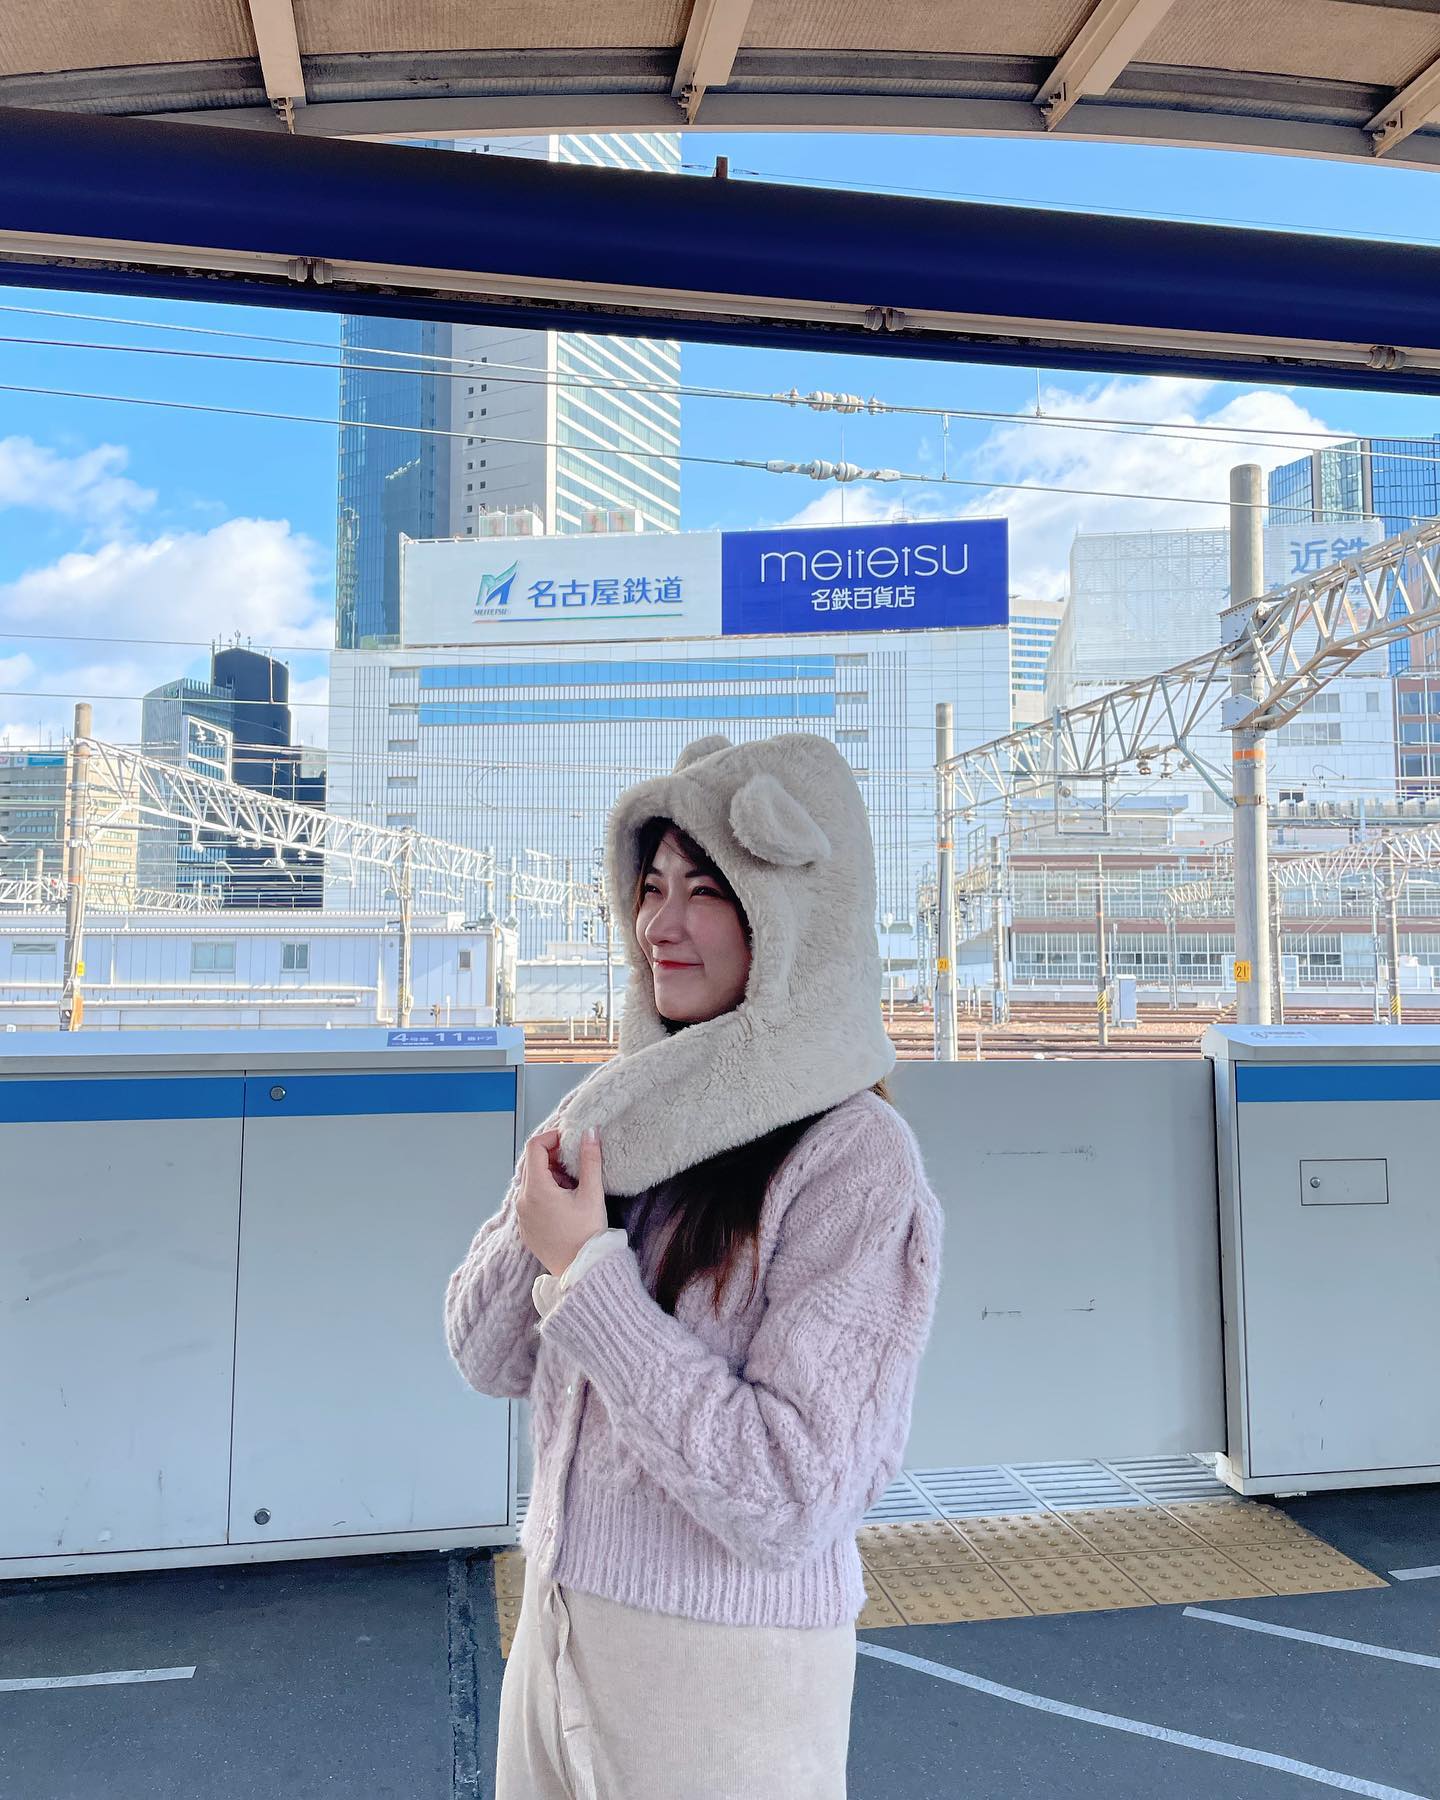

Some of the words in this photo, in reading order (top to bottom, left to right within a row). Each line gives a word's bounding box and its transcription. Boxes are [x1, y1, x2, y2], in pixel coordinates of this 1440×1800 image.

[527, 576, 684, 608] 名古屋鉄道
[811, 585, 916, 611] 名鉄百貨店
[1235, 966, 1247, 978] 21
